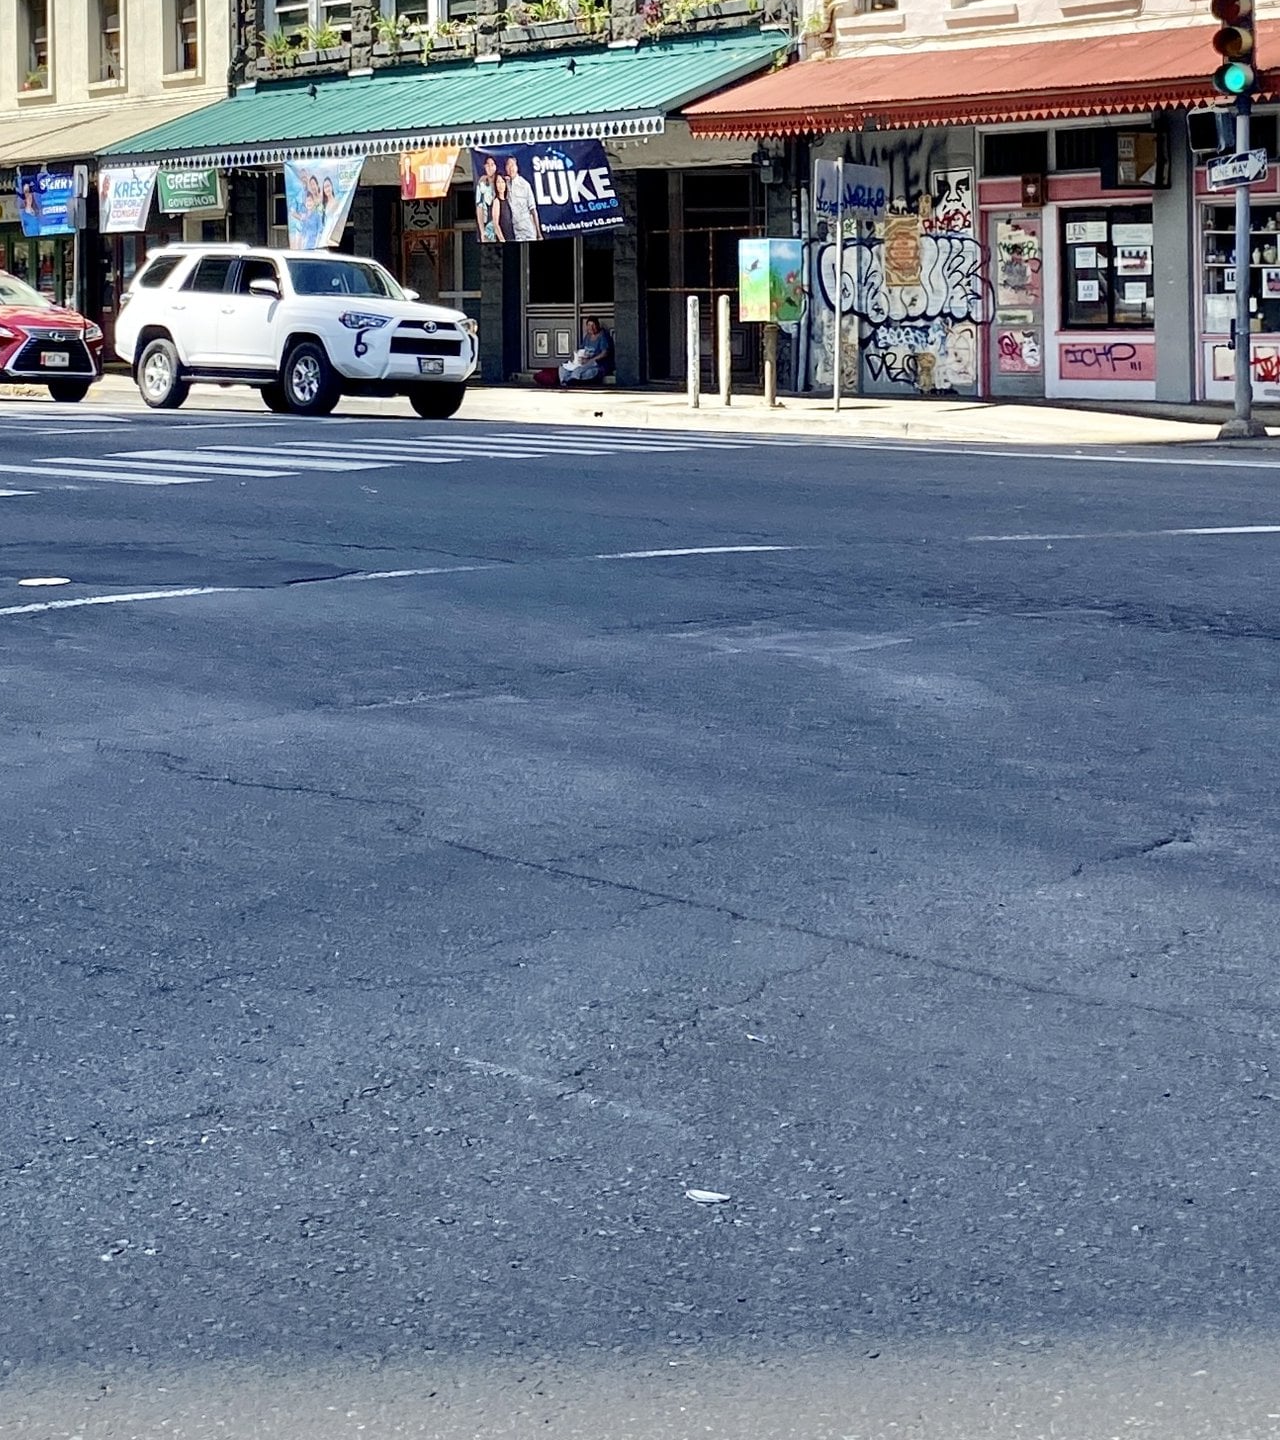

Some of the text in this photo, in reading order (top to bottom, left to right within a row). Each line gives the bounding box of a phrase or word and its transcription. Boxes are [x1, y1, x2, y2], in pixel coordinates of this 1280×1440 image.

[532, 156, 564, 173] Sylvia
[1232, 163, 1248, 175] WAY
[113, 180, 150, 199] KRESS
[166, 172, 210, 190] GREEN
[534, 167, 616, 205] LUKE
[168, 195, 216, 208] GOVERNOR
[589, 201, 611, 211] Gov.
